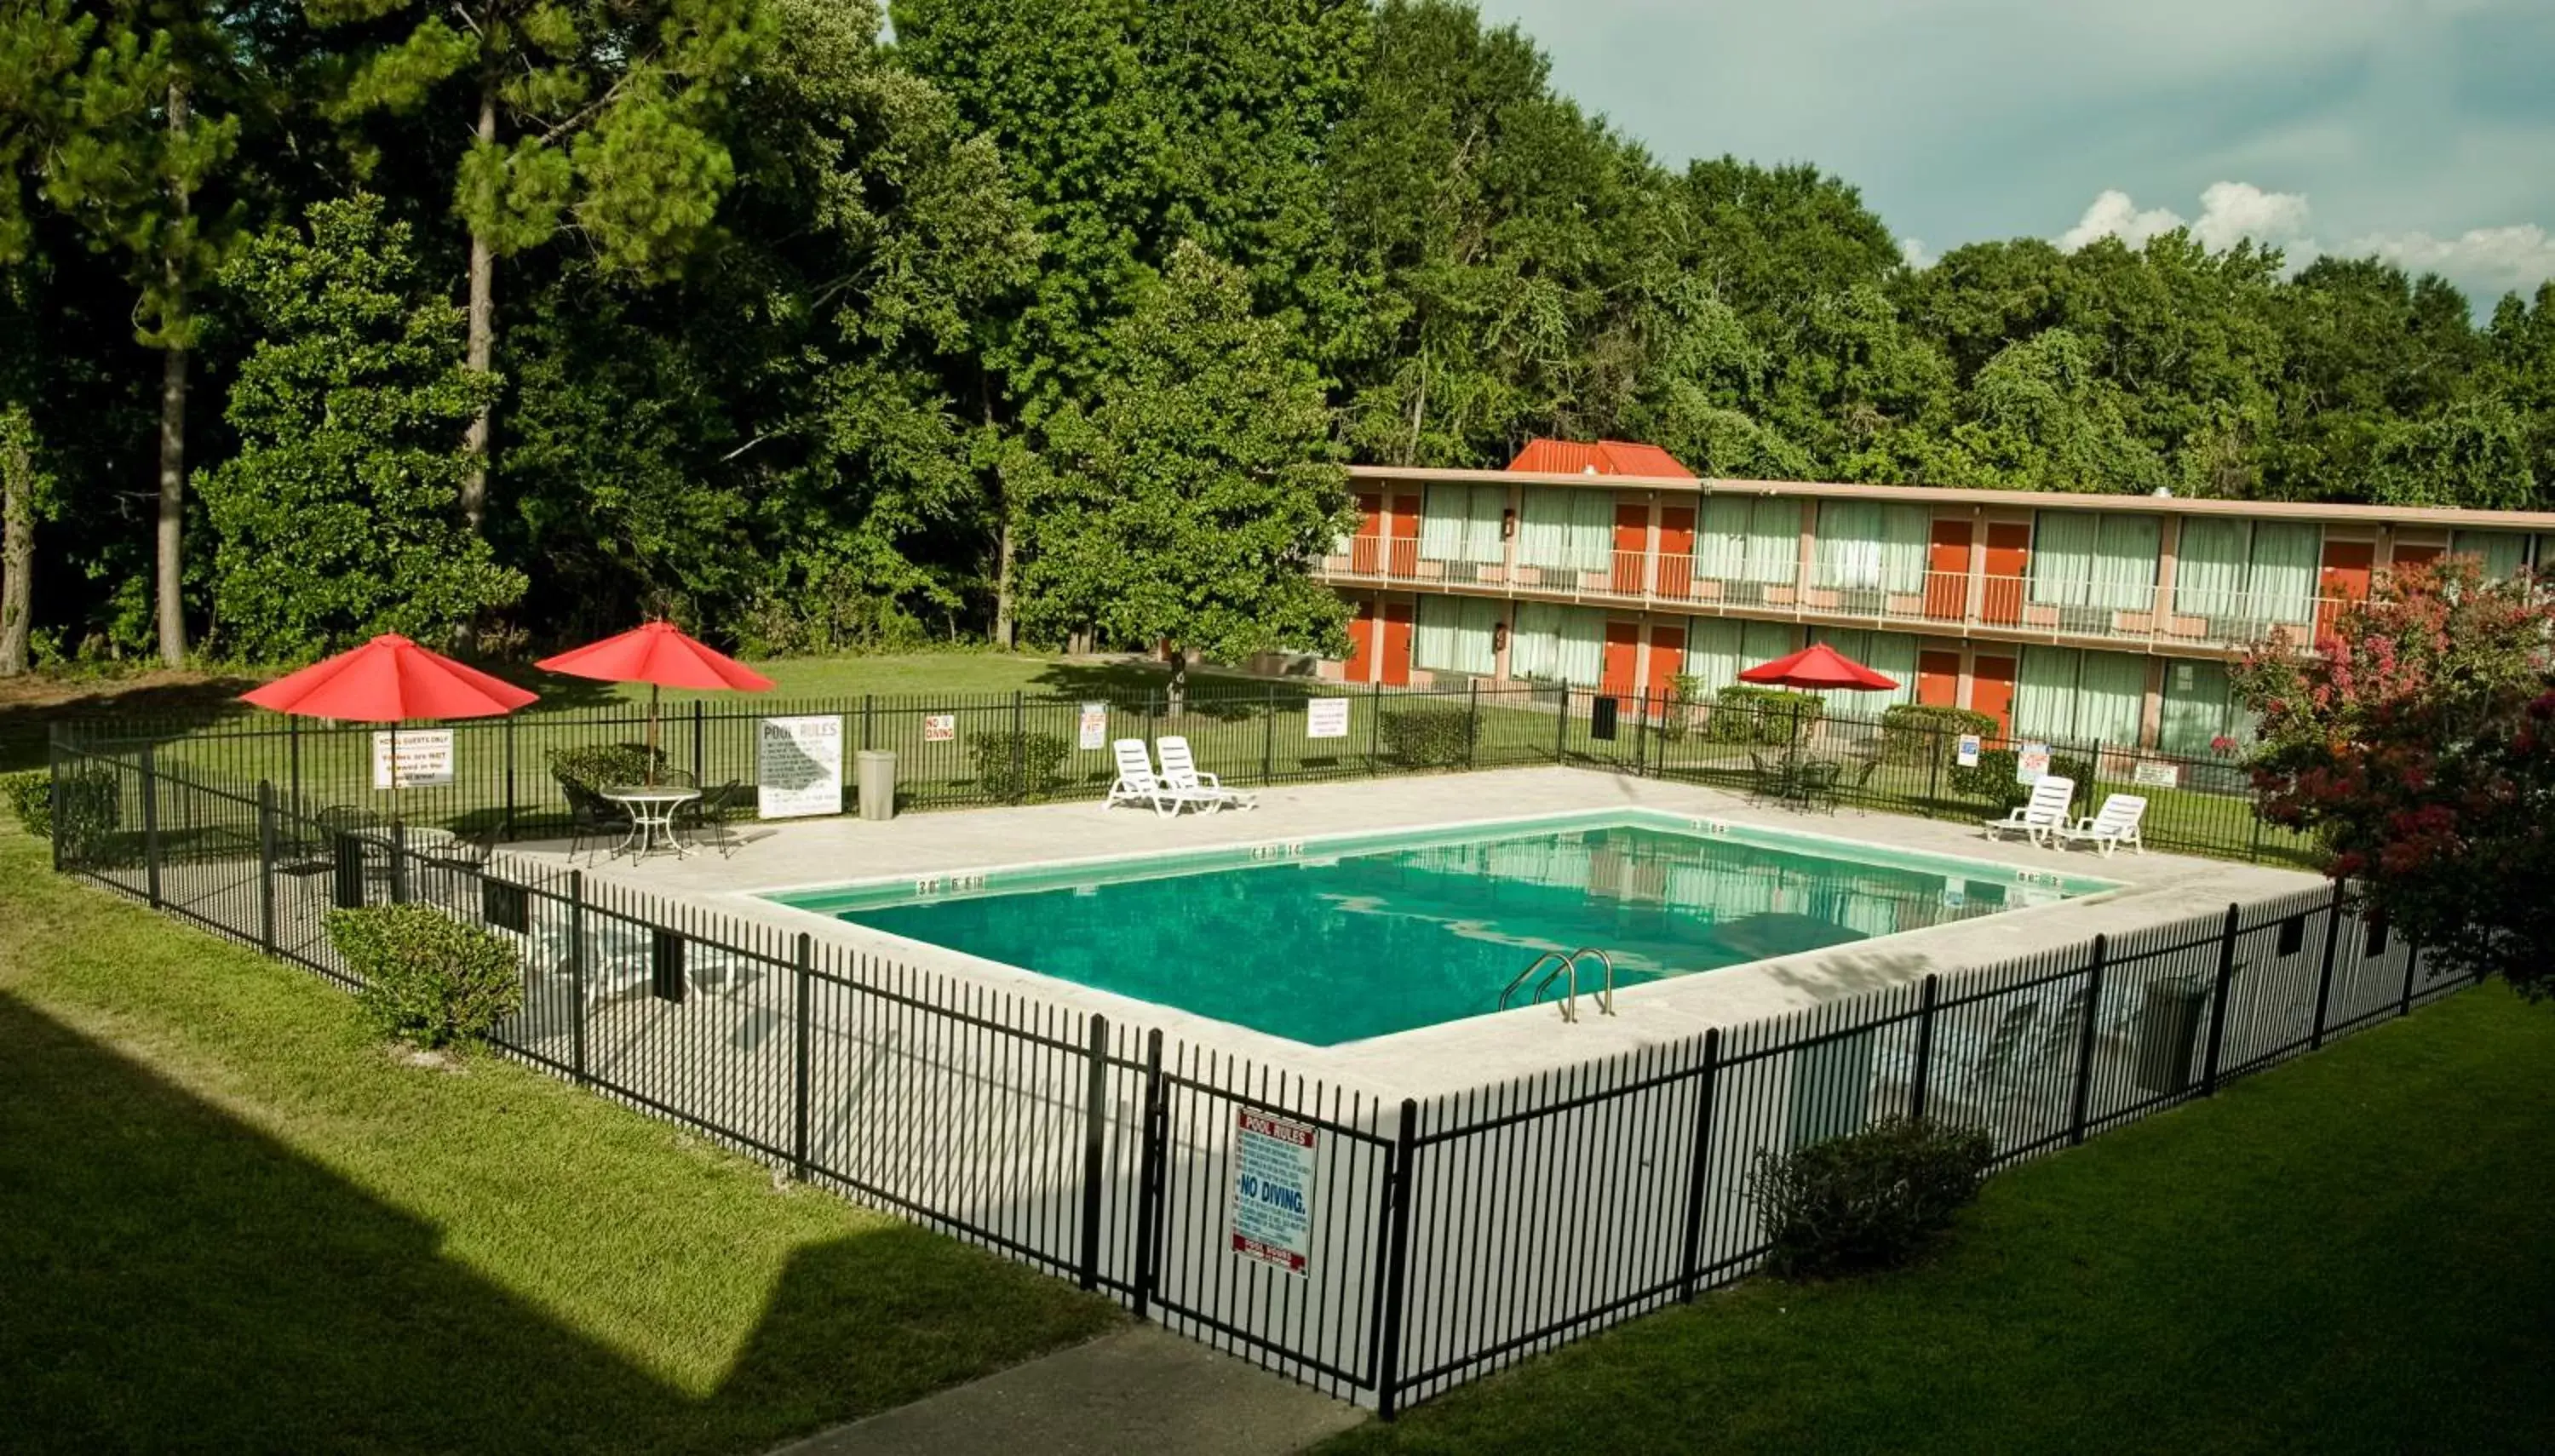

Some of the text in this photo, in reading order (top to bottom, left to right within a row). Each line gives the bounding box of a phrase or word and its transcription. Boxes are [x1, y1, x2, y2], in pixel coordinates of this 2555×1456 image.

[1246, 1116, 1306, 1145] POOL RULES
[1240, 1173, 1258, 1198] NO
